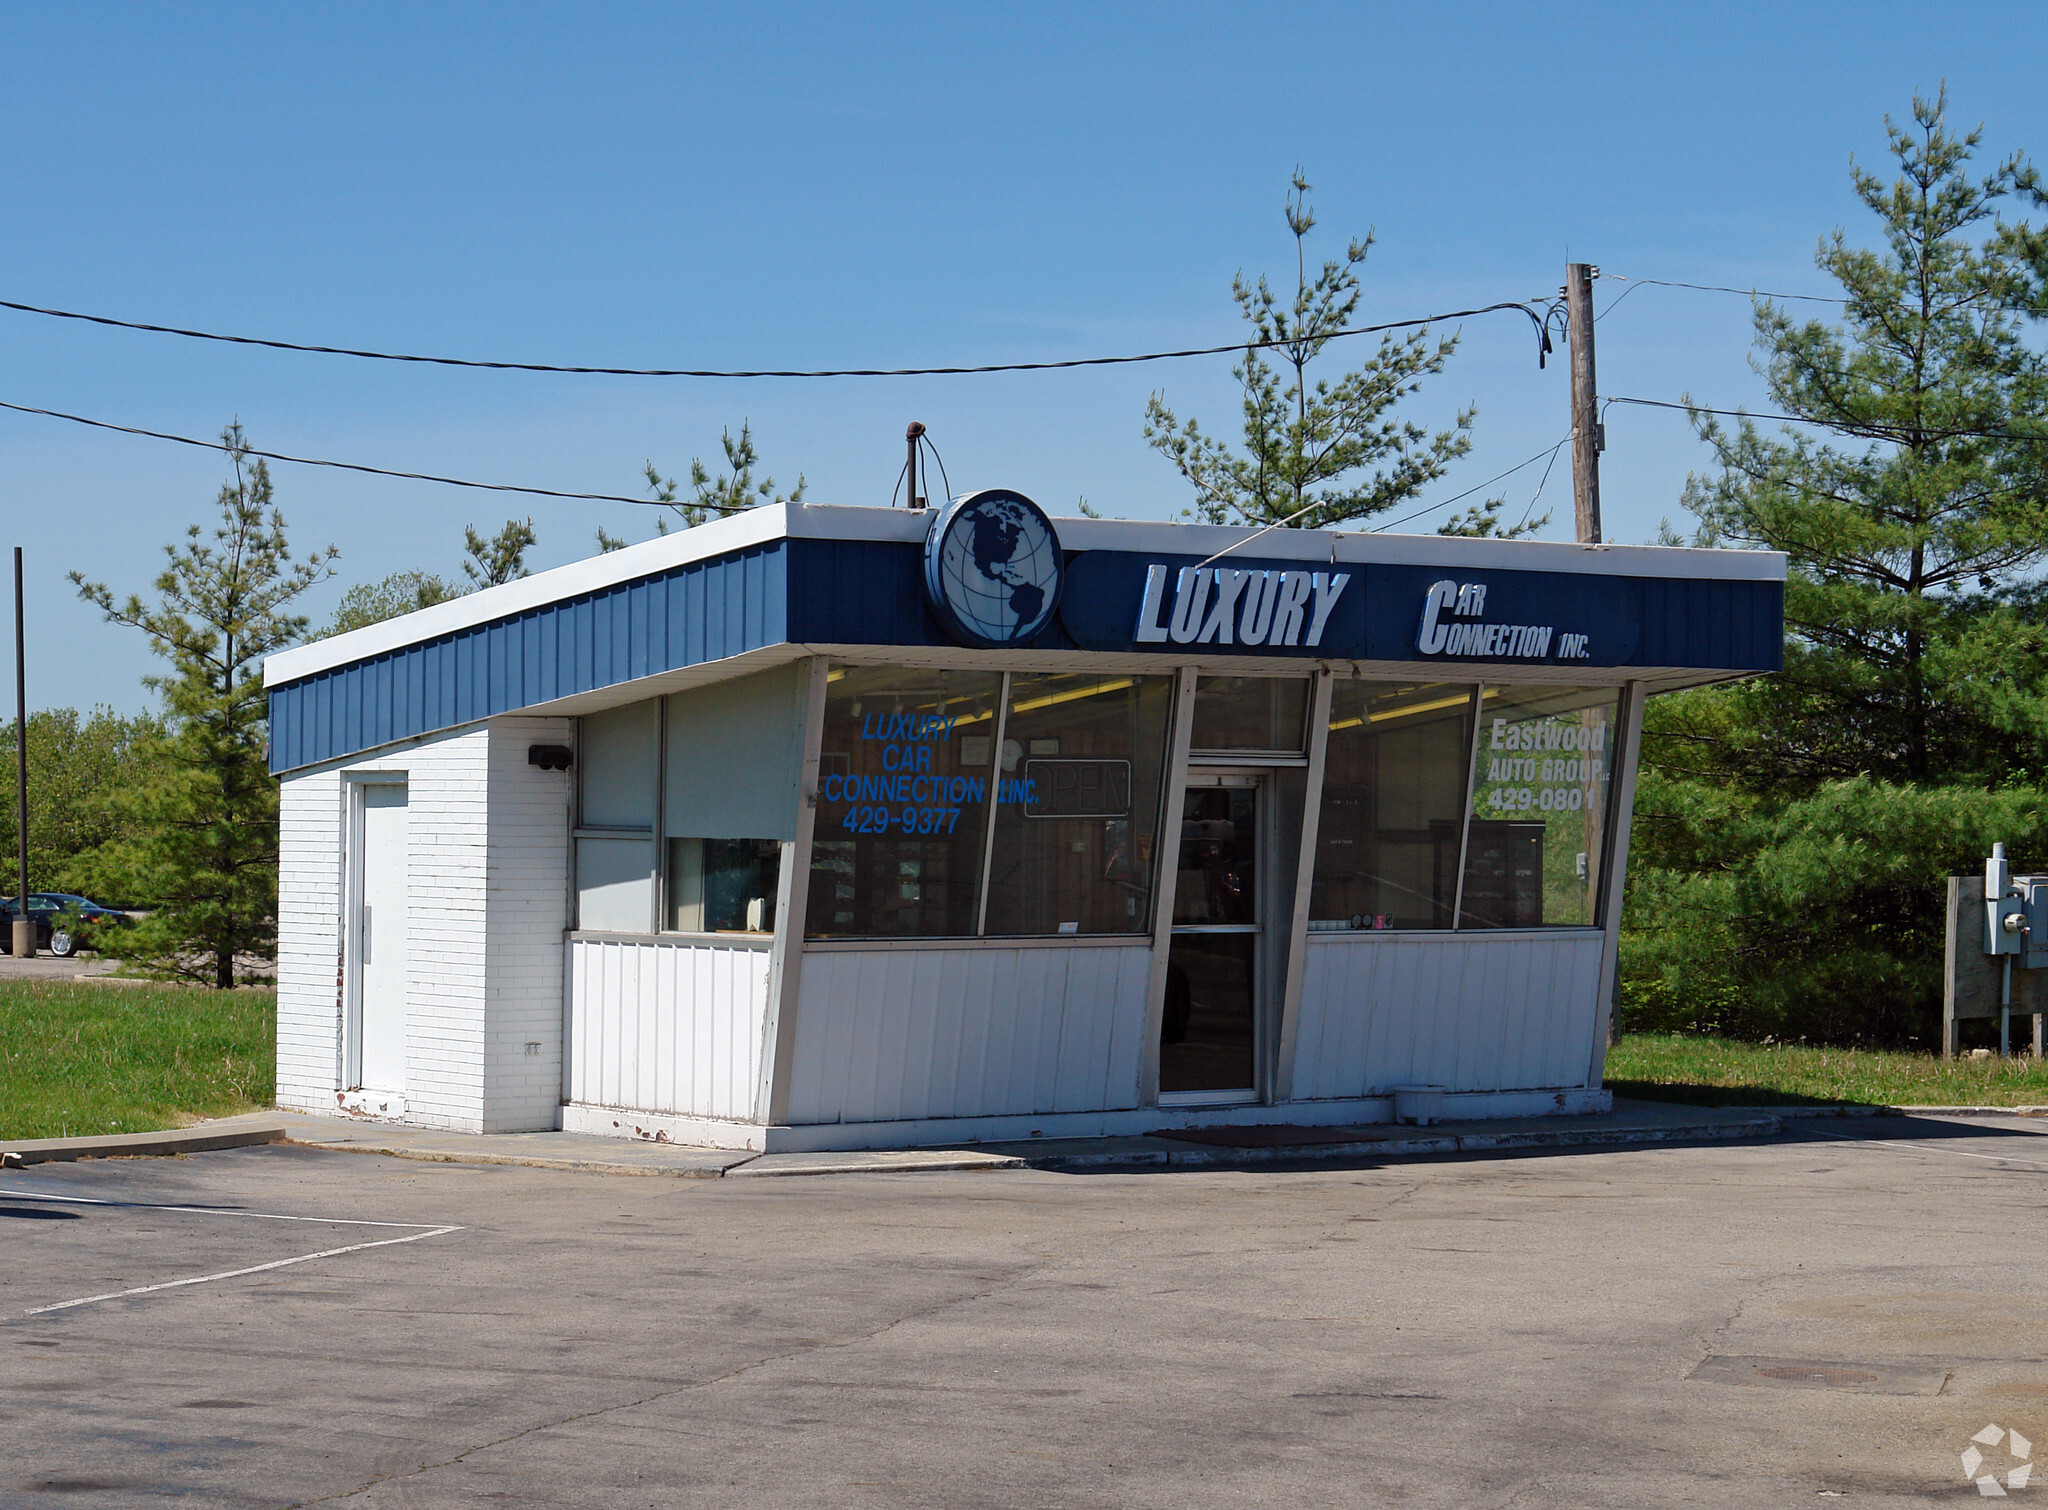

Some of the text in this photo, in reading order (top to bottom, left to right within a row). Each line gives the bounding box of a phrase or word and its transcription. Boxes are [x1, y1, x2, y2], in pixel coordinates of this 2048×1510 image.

[1136, 564, 1351, 647] LUXURY
[1557, 632, 1590, 660] INC.
[861, 713, 959, 742] LUXURY
[1491, 718, 1606, 751] Eastwood
[882, 744, 932, 772] CAR
[1488, 758, 1536, 782] AUTO
[1541, 758, 1603, 782] GROUP
[824, 774, 985, 804] CONNECTION
[1029, 764, 1126, 811] OPEN
[1488, 788, 1595, 811] 429-0801
[842, 806, 962, 835] 429-9377
